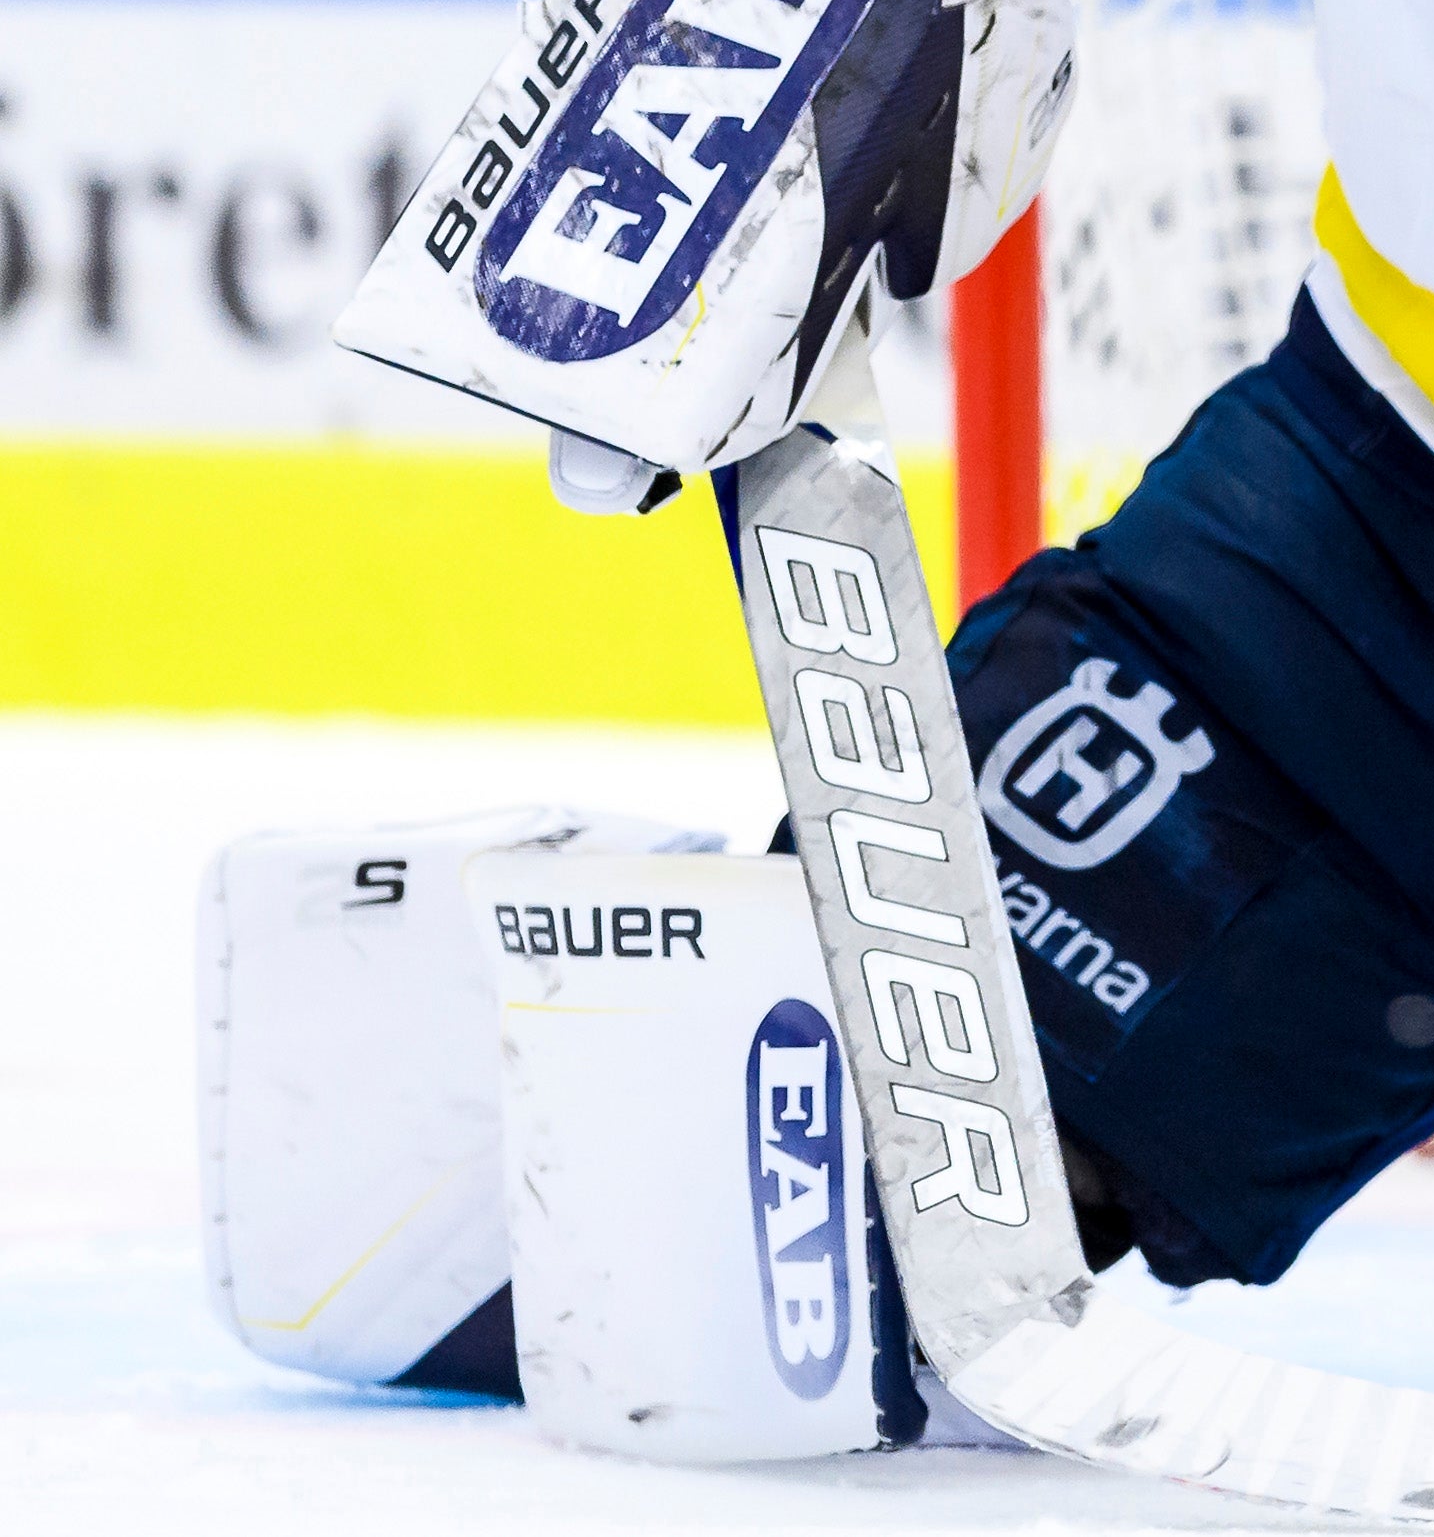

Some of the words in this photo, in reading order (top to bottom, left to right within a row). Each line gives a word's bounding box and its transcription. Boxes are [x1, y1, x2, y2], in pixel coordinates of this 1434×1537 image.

[495, 904, 707, 960] BAUER
[754, 526, 1030, 1229] BAUER
[757, 1039, 847, 1371] EAB
